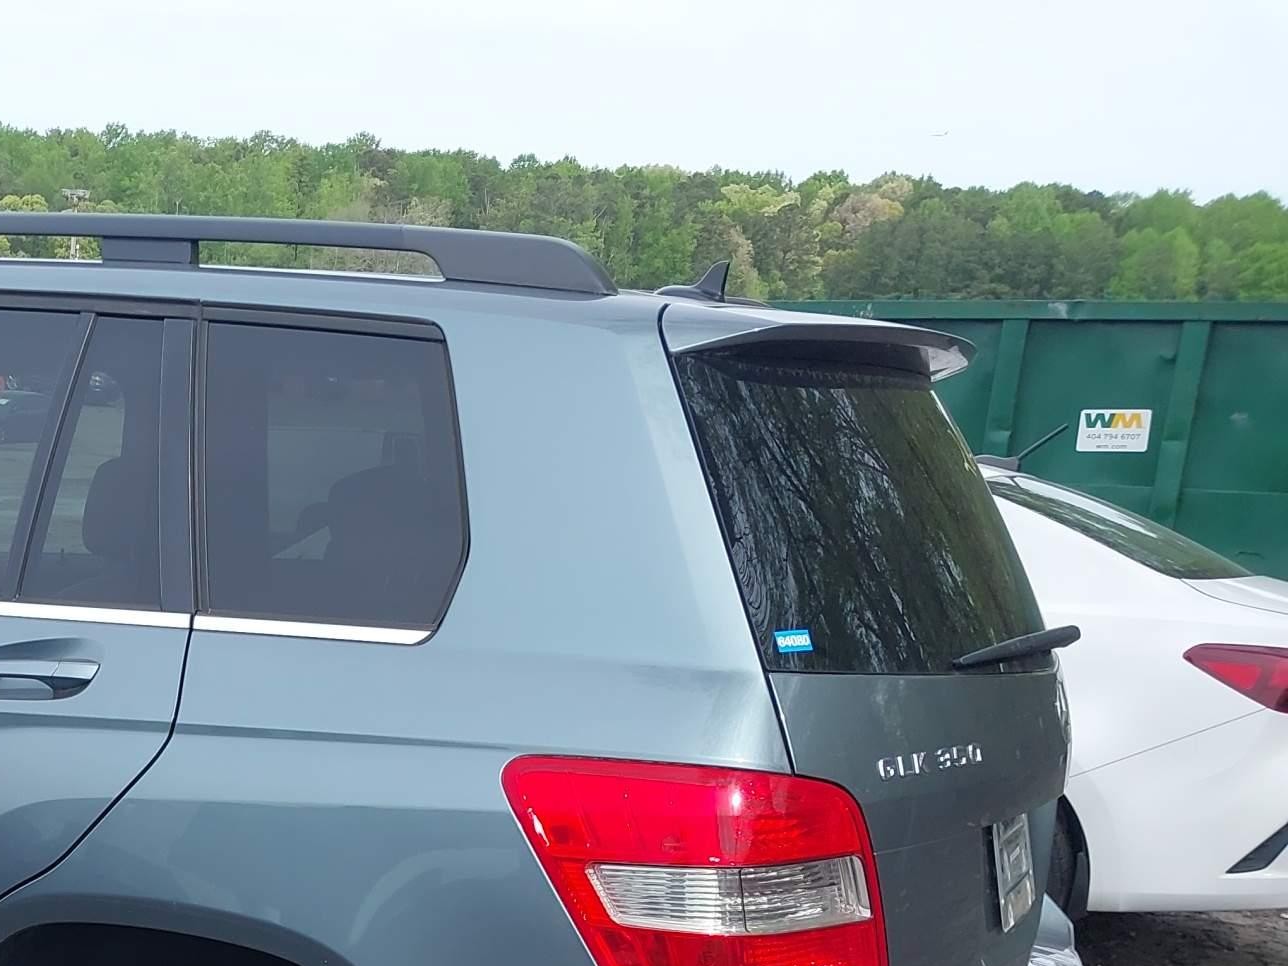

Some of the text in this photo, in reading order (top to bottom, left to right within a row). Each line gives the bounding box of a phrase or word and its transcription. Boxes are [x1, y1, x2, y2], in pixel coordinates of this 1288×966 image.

[1084, 412, 1143, 428] WM
[877, 742, 982, 780] GLK 350
